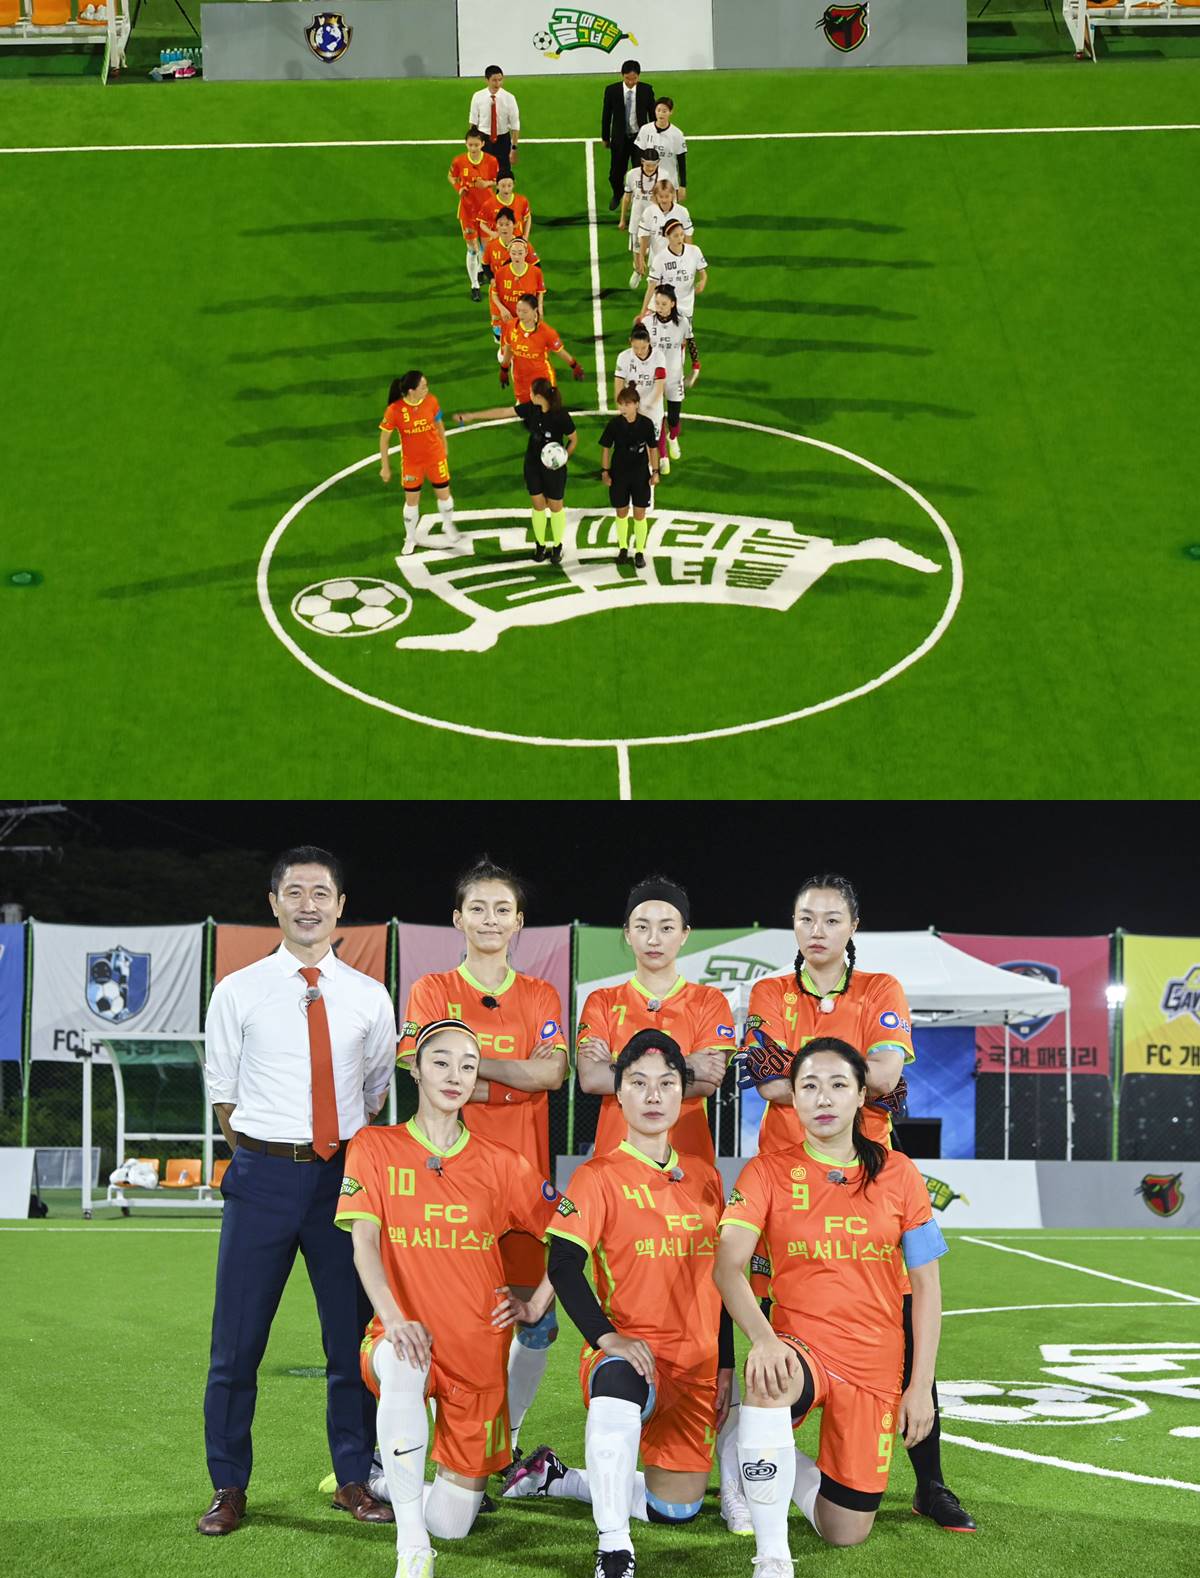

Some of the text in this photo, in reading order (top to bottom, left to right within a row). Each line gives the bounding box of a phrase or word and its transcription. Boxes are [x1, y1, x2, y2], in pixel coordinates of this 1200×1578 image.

[664, 261, 677, 271] 100
[612, 1005, 627, 1026] 7
[785, 1007, 798, 1031] 4
[476, 1033, 514, 1053] FC
[1146, 1044, 1172, 1066] FC
[387, 1166, 416, 1197] 10
[622, 1184, 657, 1209] 41
[792, 1183, 810, 1211] 9
[424, 1203, 469, 1224] FC
[665, 1214, 704, 1232] FC
[824, 1215, 869, 1235] FC
[634, 1236, 720, 1259] 액셔니스
[876, 1433, 895, 1473] 9
